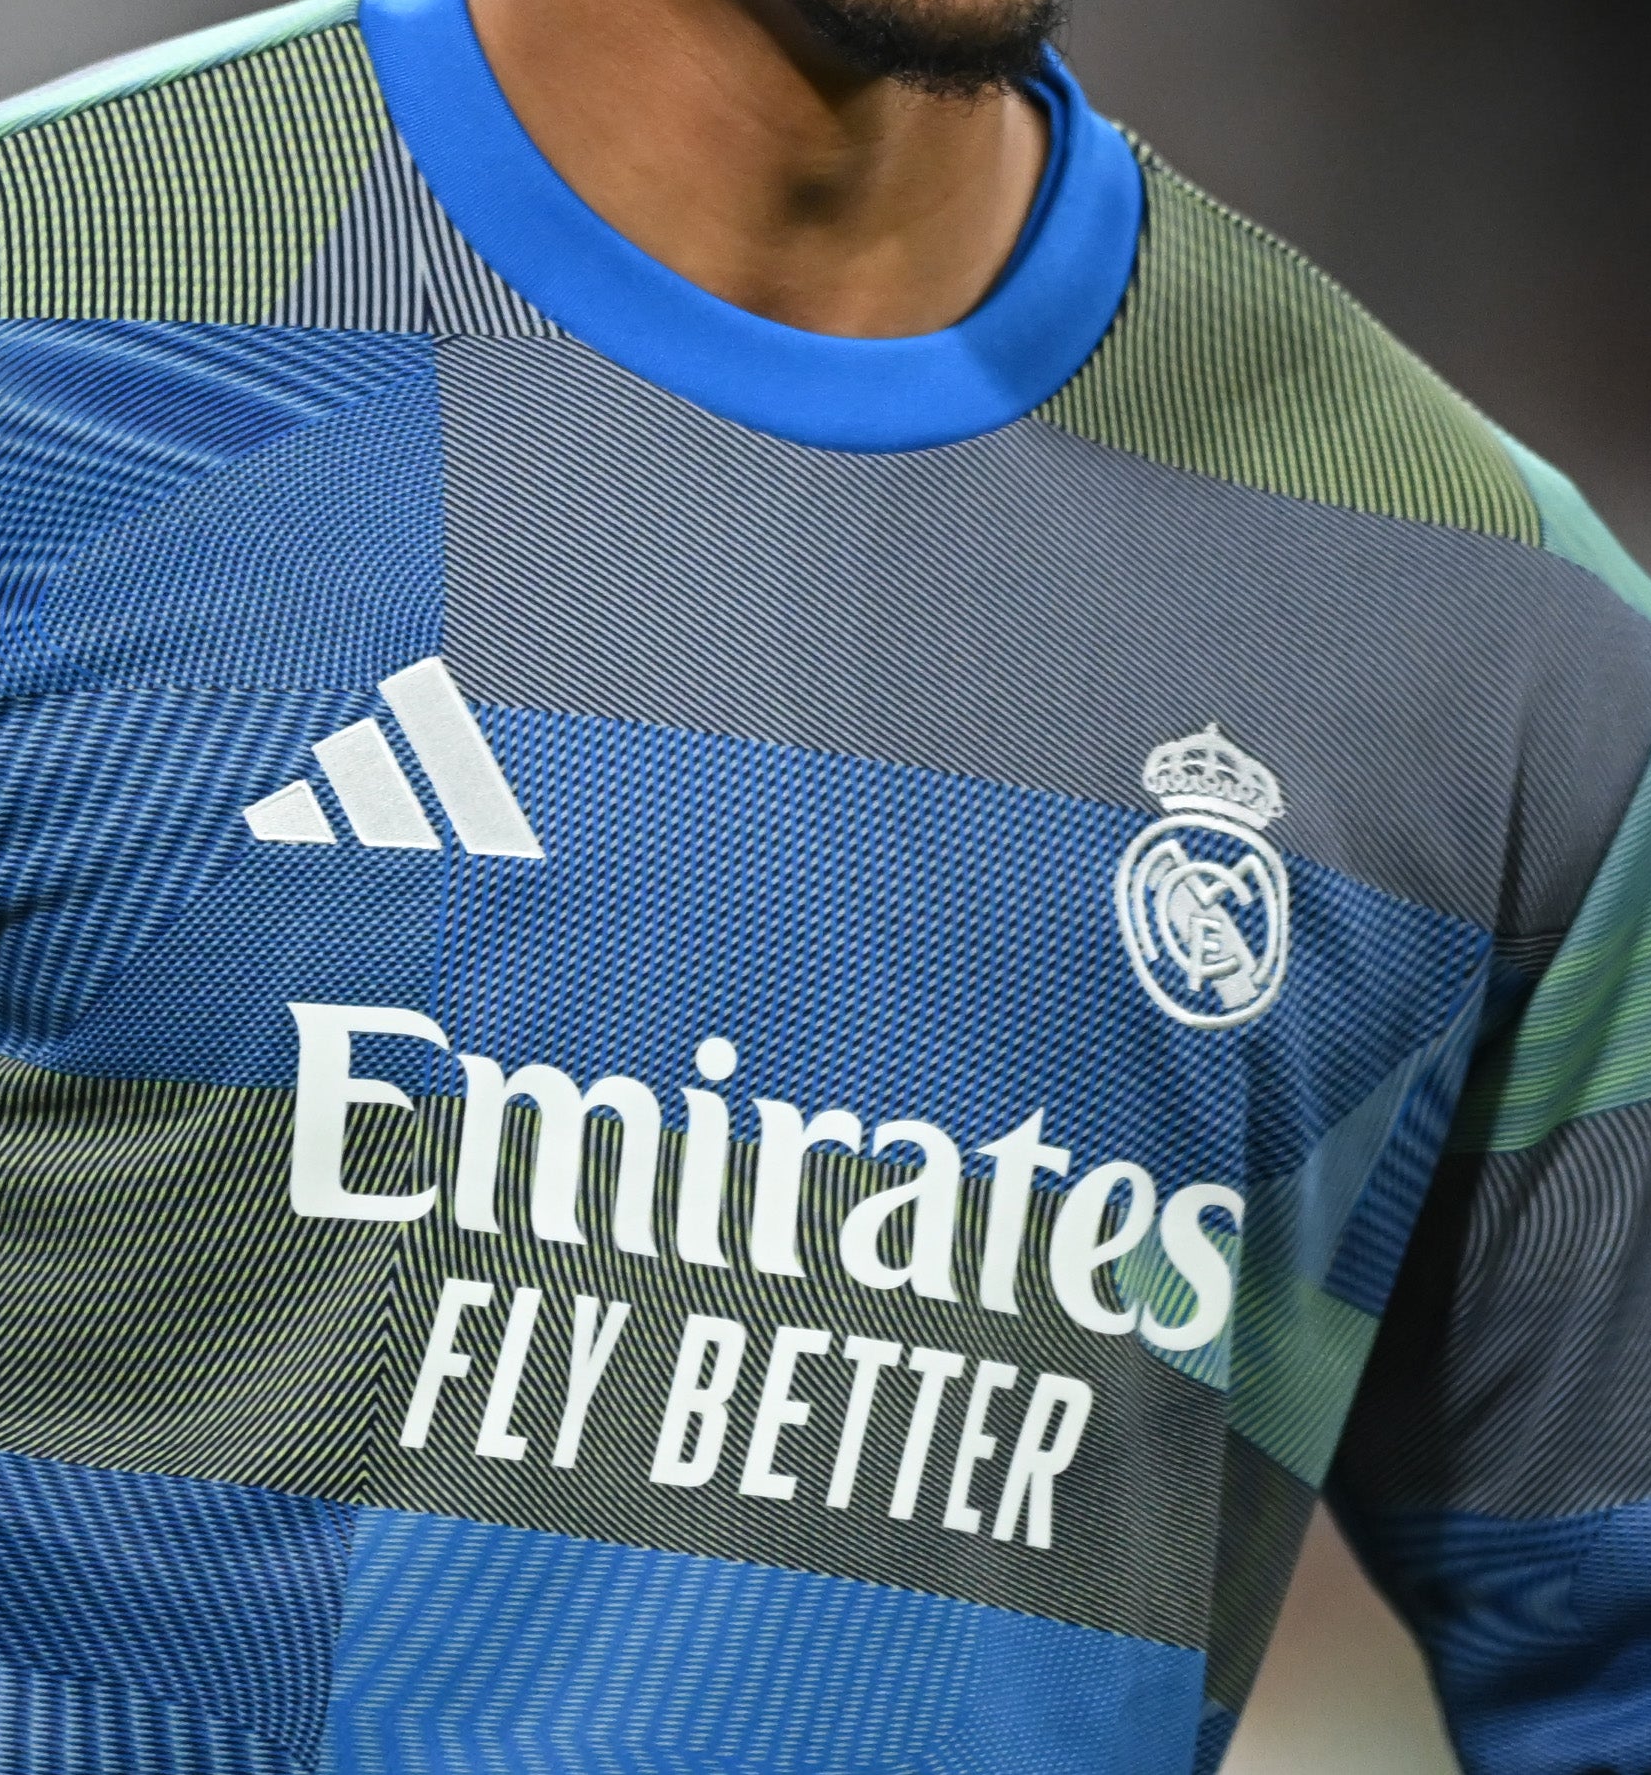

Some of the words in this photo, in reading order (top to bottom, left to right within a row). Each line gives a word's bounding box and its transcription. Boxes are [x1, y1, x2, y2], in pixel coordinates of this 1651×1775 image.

[287, 1001, 1246, 1352] Emirates
[398, 1277, 631, 1470] FLY
[648, 1312, 1094, 1550] BETTER
